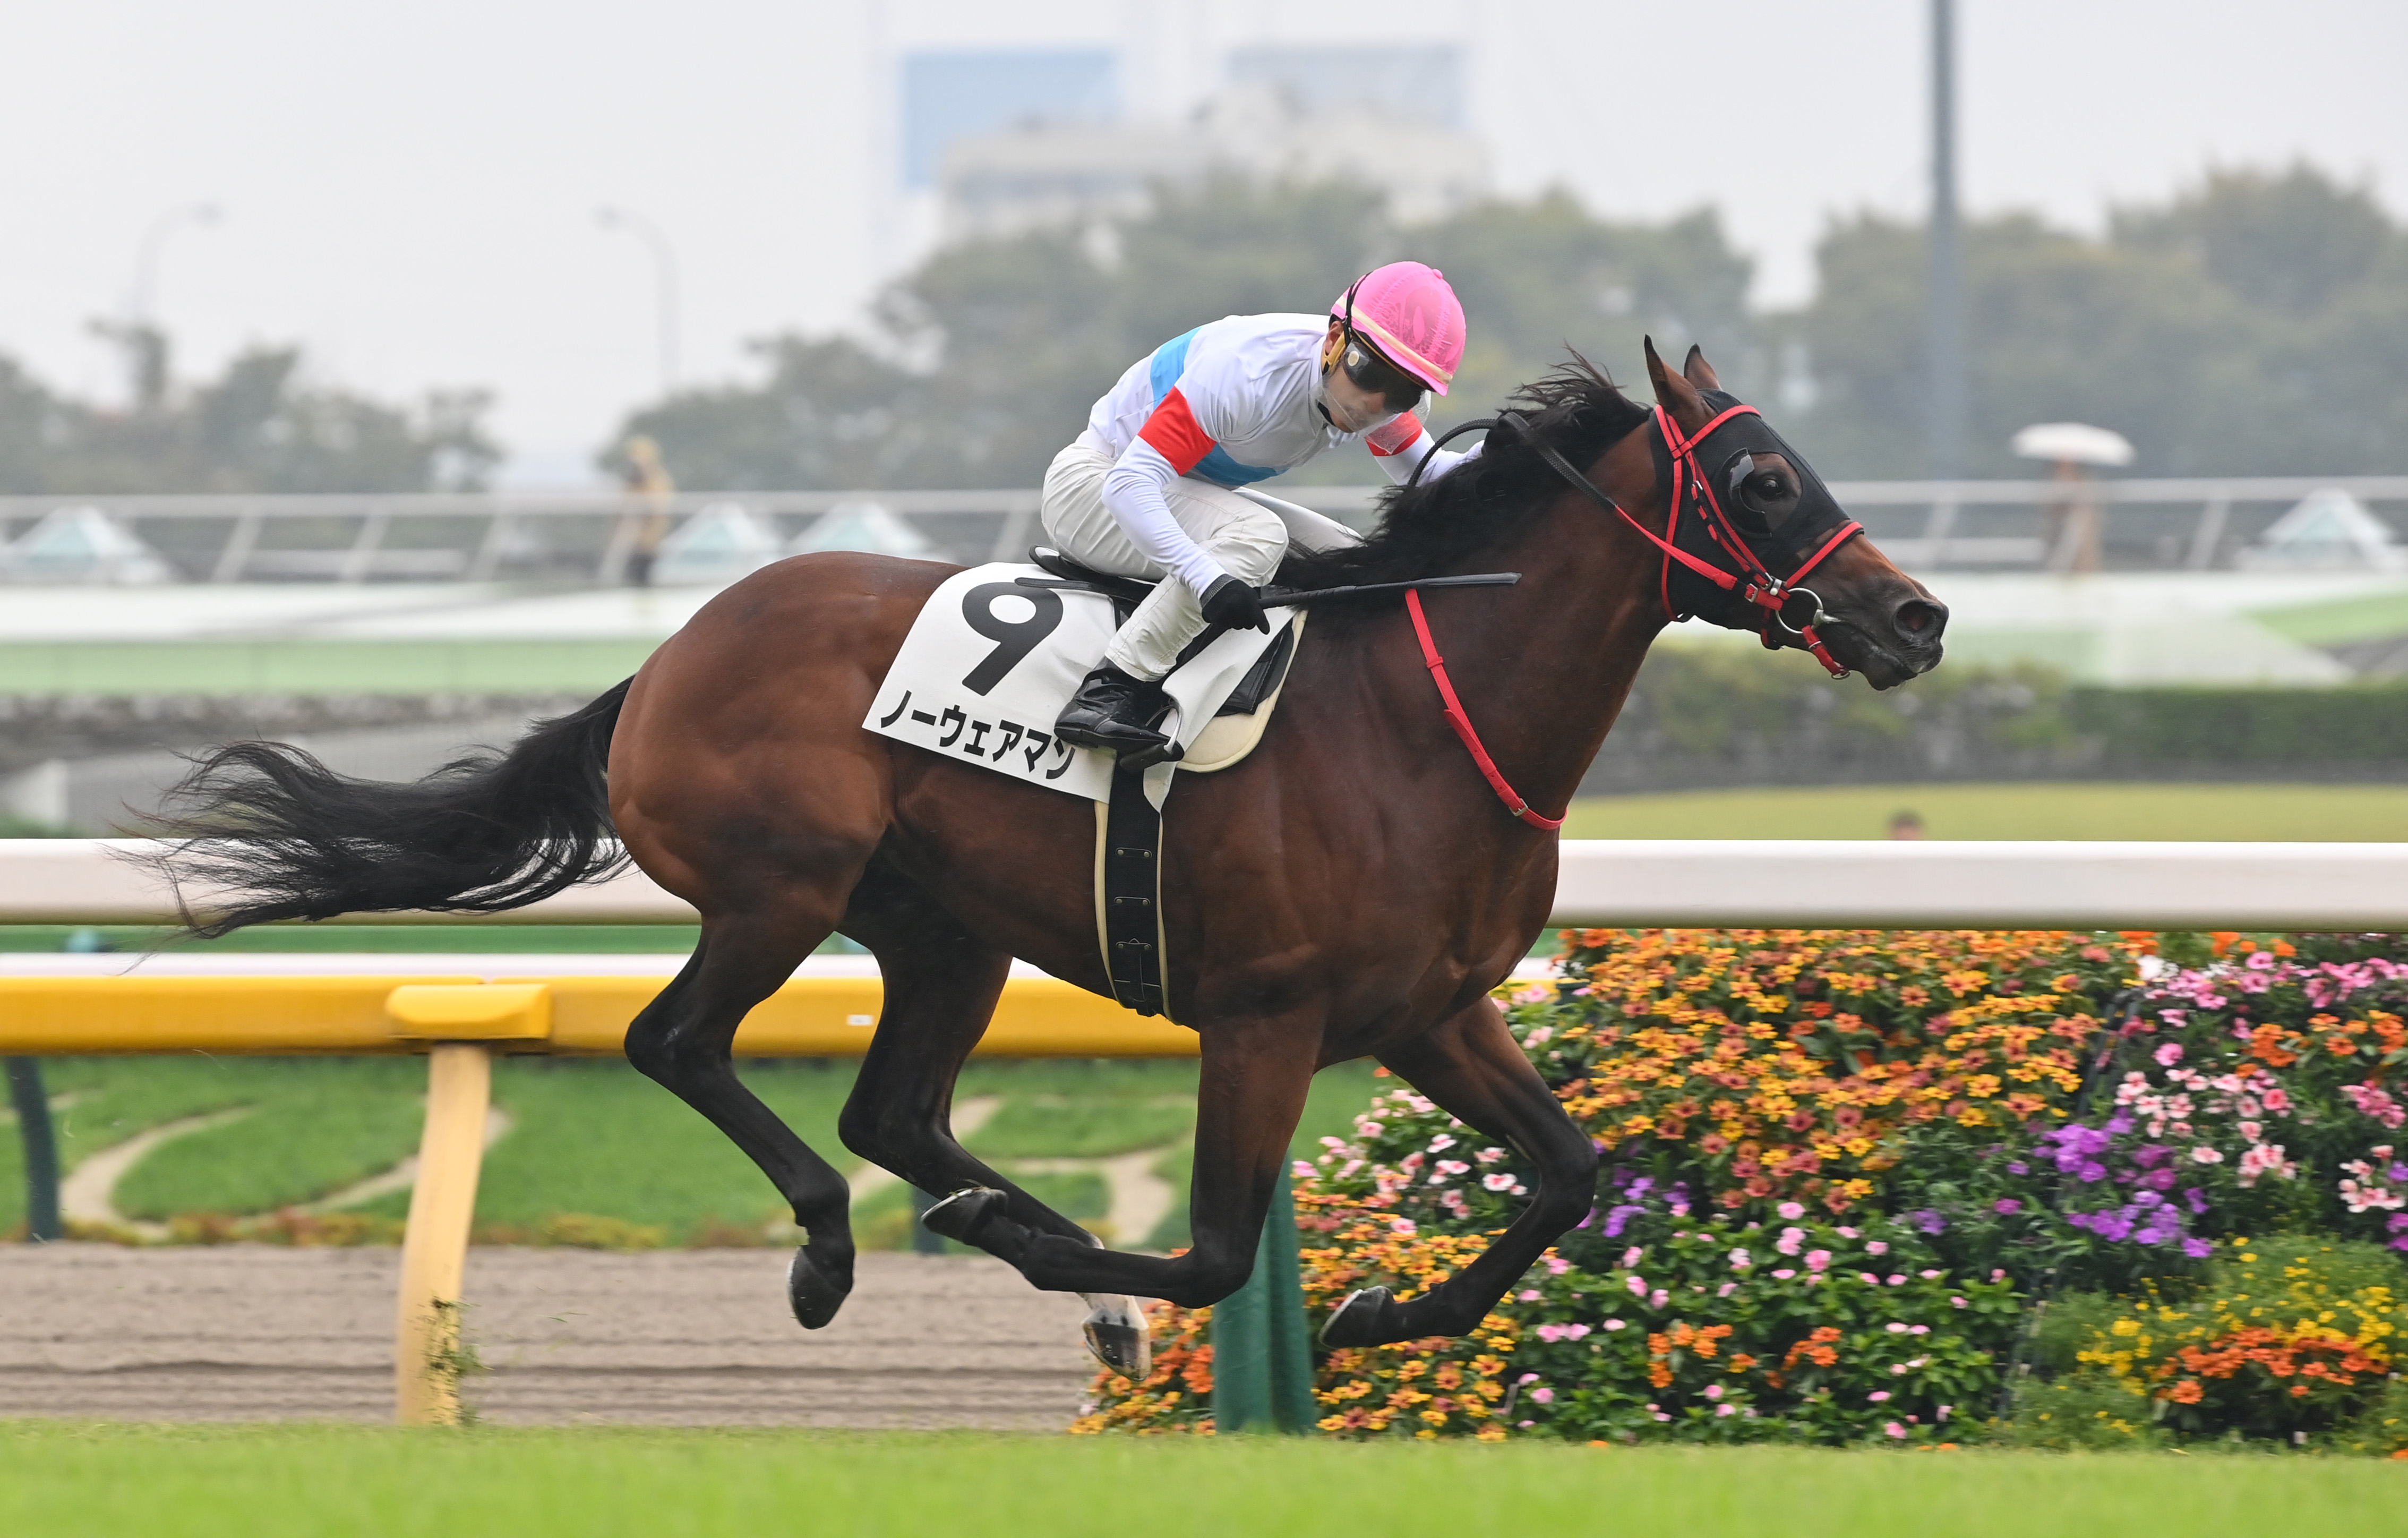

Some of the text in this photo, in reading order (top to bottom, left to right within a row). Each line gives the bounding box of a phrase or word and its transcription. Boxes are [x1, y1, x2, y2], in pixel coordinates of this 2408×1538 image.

[962, 582, 1064, 696] 9
[880, 689, 1076, 780] ノーウェアマン
